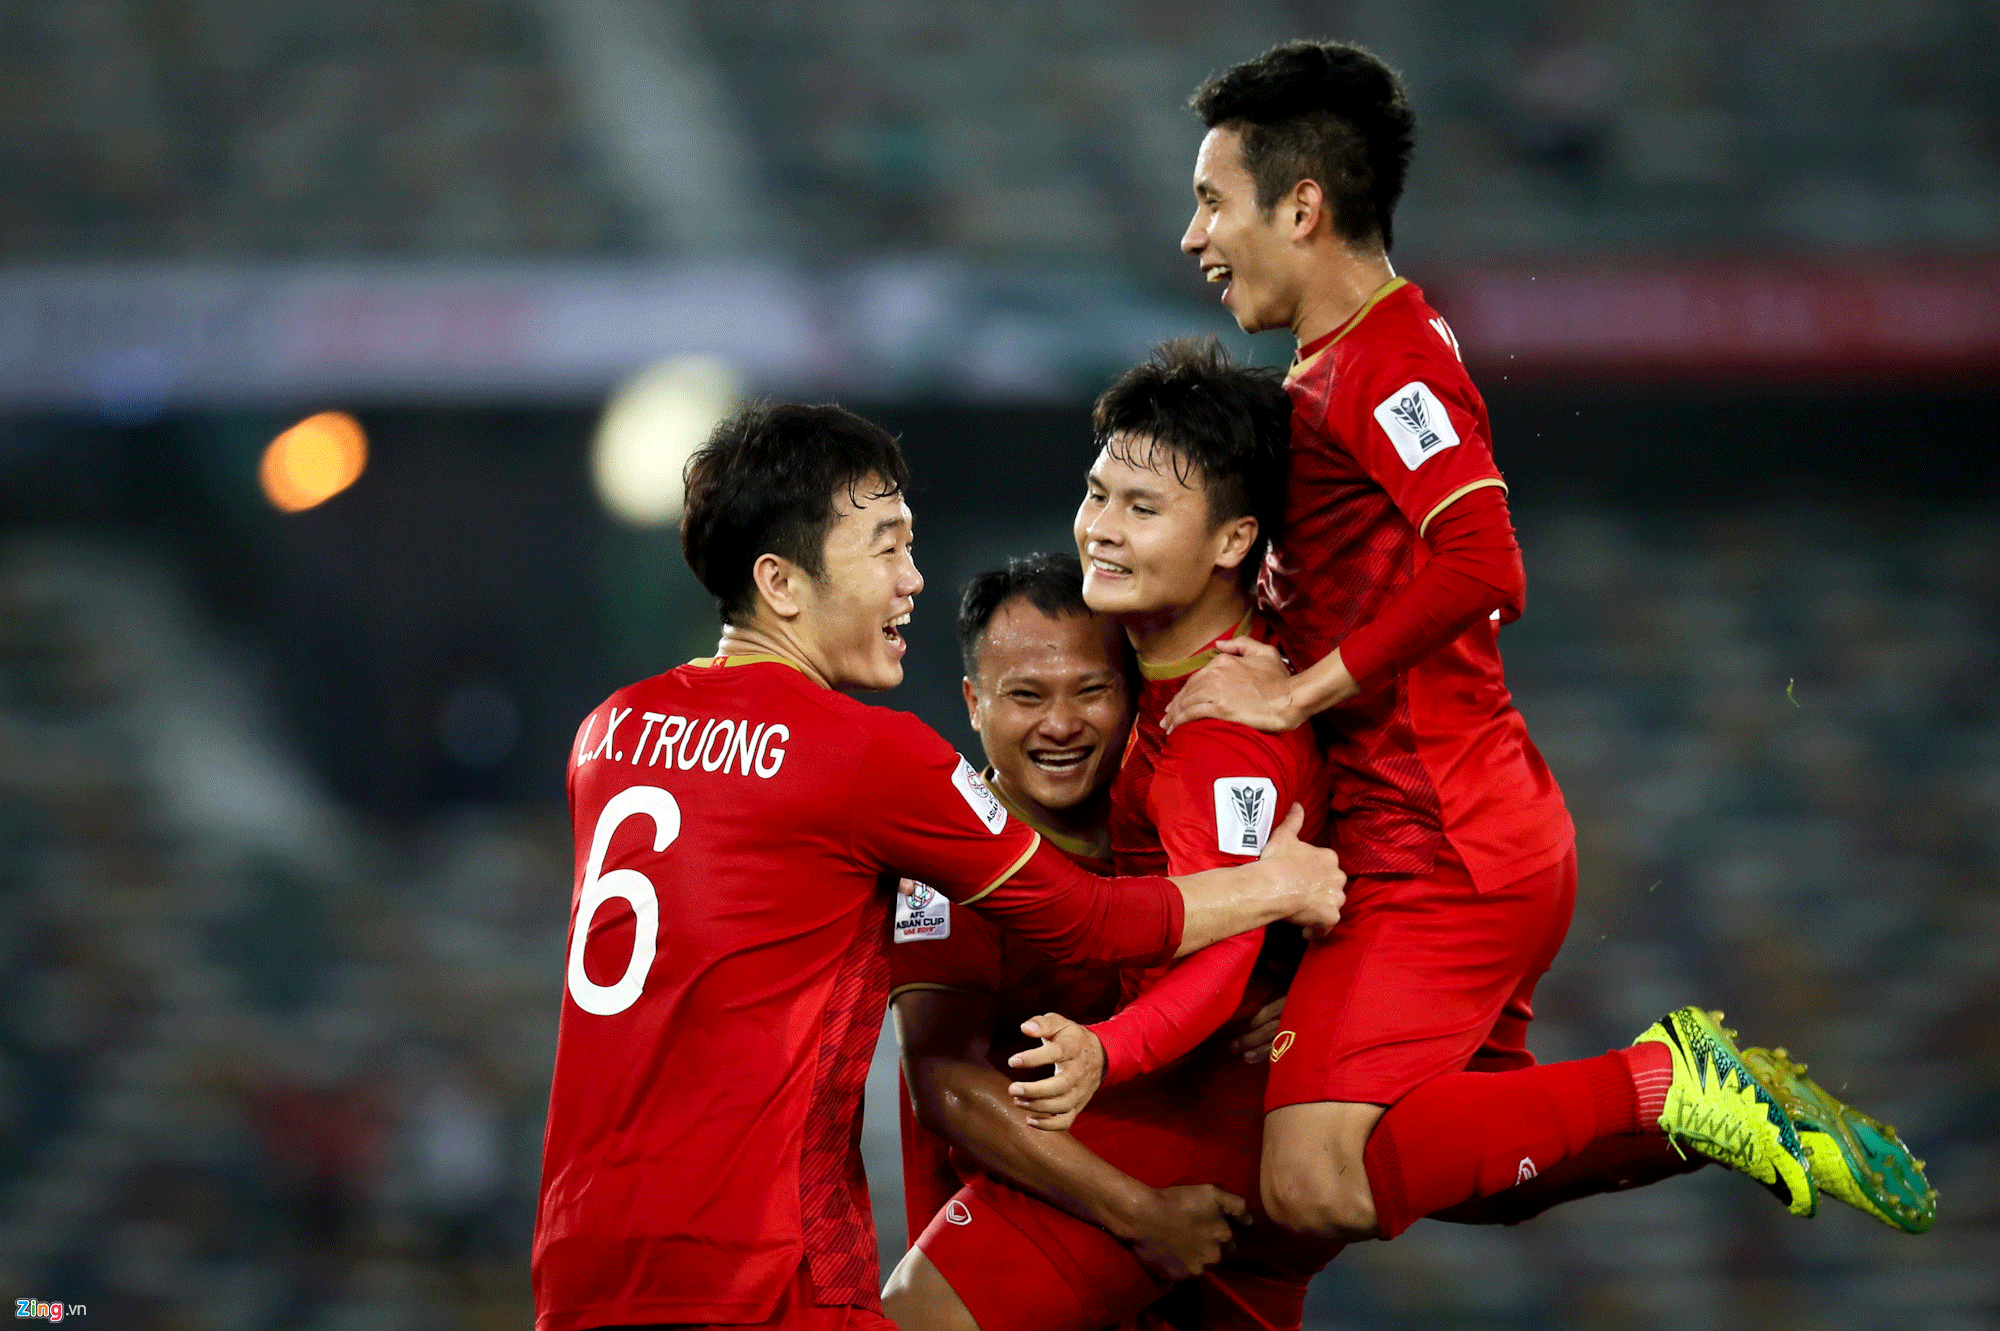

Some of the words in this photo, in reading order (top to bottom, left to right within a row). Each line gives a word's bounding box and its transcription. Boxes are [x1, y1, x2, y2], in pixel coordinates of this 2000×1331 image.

[567, 785, 682, 1016] 6
[896, 919, 921, 930] ASIAN
[923, 917, 945, 926] CUP
